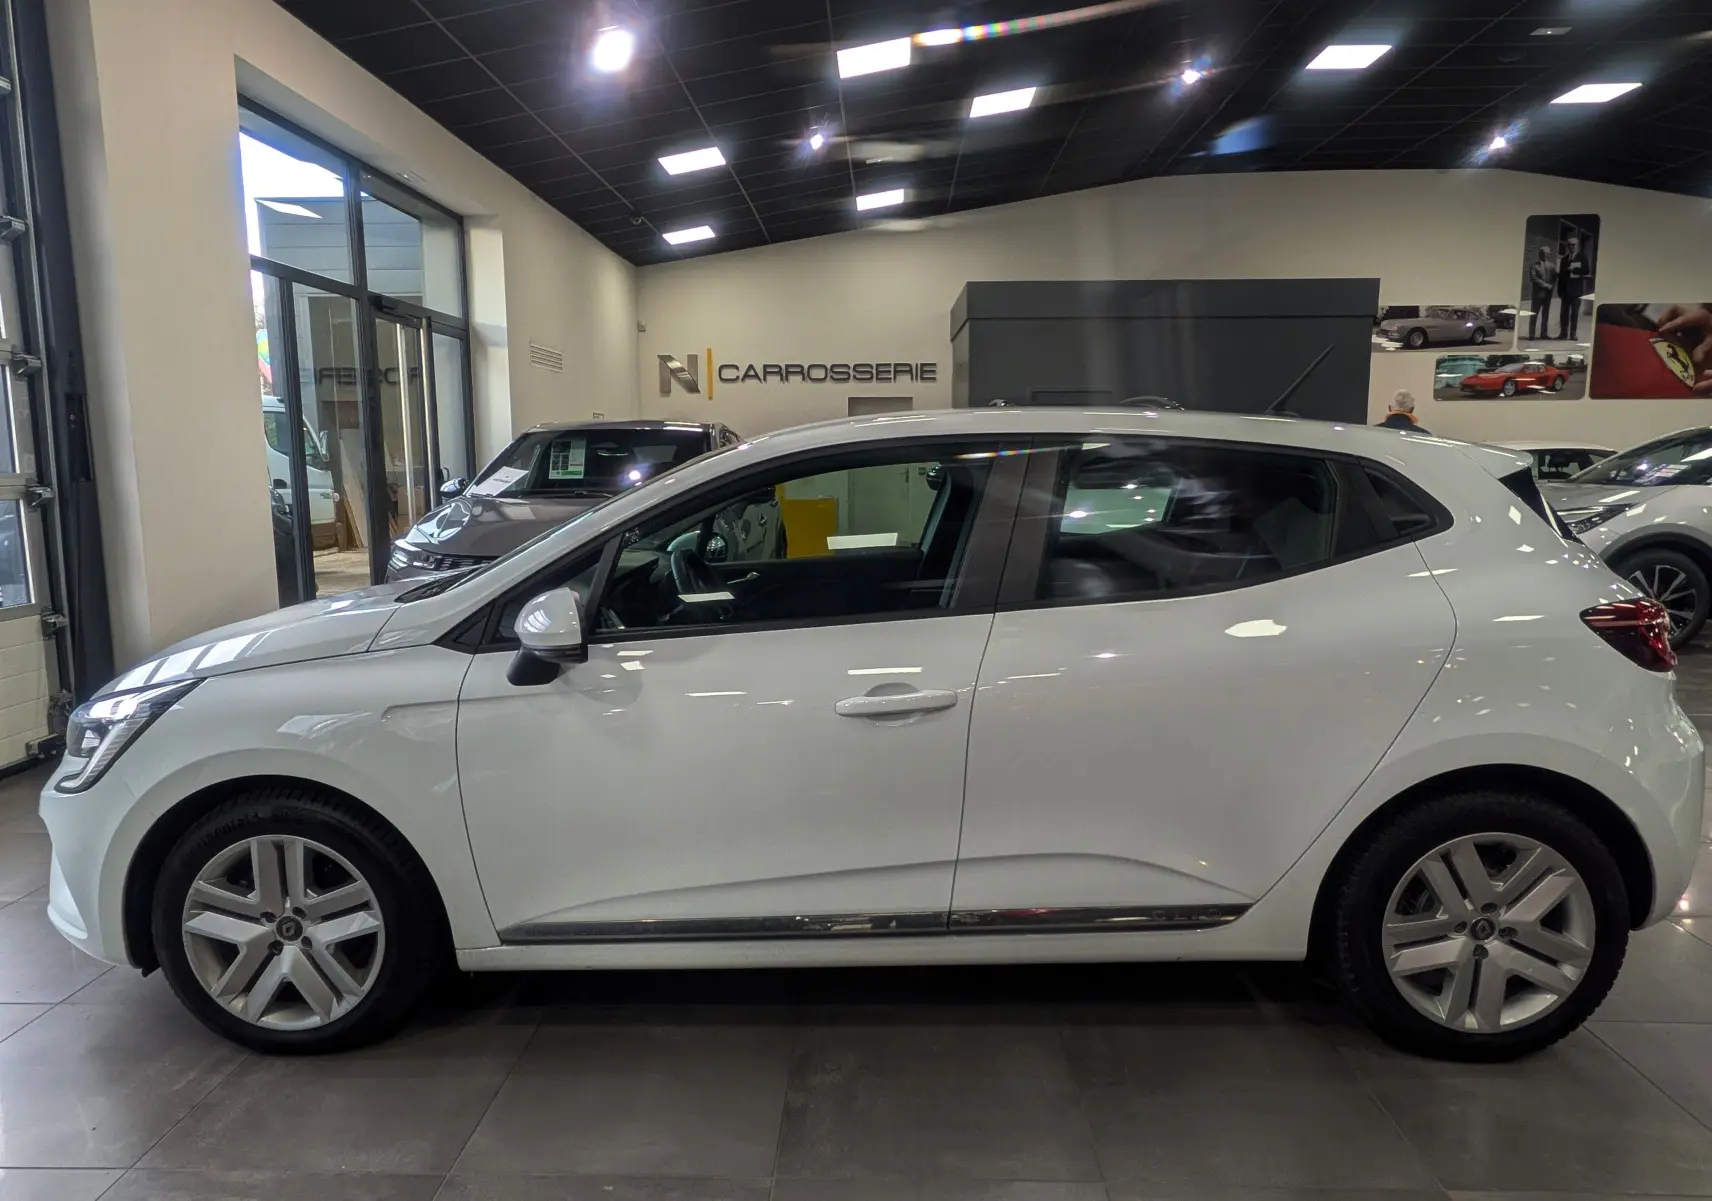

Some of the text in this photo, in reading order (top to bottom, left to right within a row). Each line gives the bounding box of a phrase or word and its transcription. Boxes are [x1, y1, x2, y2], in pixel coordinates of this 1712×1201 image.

[657, 354, 937, 397] N CARROSSERIE
[1152, 909, 1222, 921] CLIO
